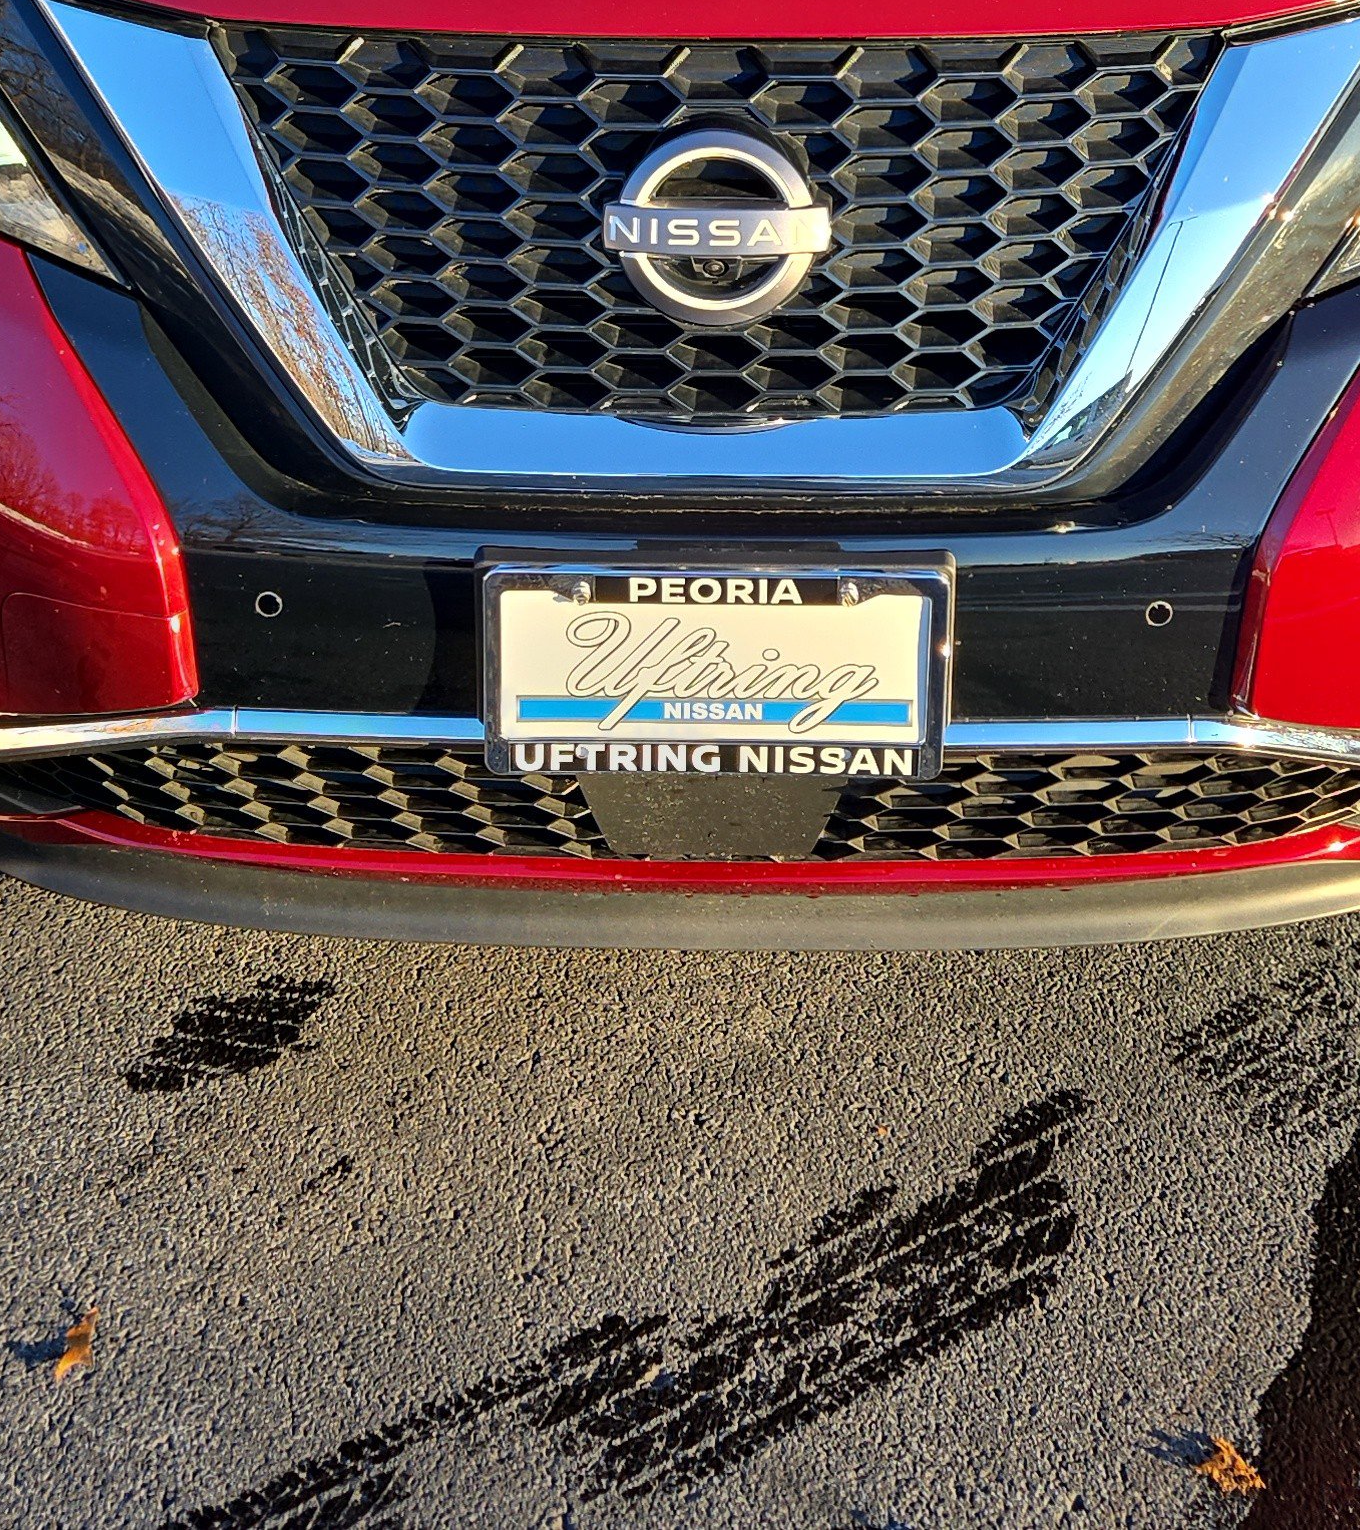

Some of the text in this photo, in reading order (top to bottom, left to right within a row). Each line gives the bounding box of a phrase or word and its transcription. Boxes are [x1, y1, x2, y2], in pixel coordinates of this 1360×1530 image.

[629, 577, 803, 605] PEORIA
[565, 610, 880, 735] Uftring
[663, 702, 764, 721] NISSAN
[514, 743, 914, 777] UFTRING NISSAN
